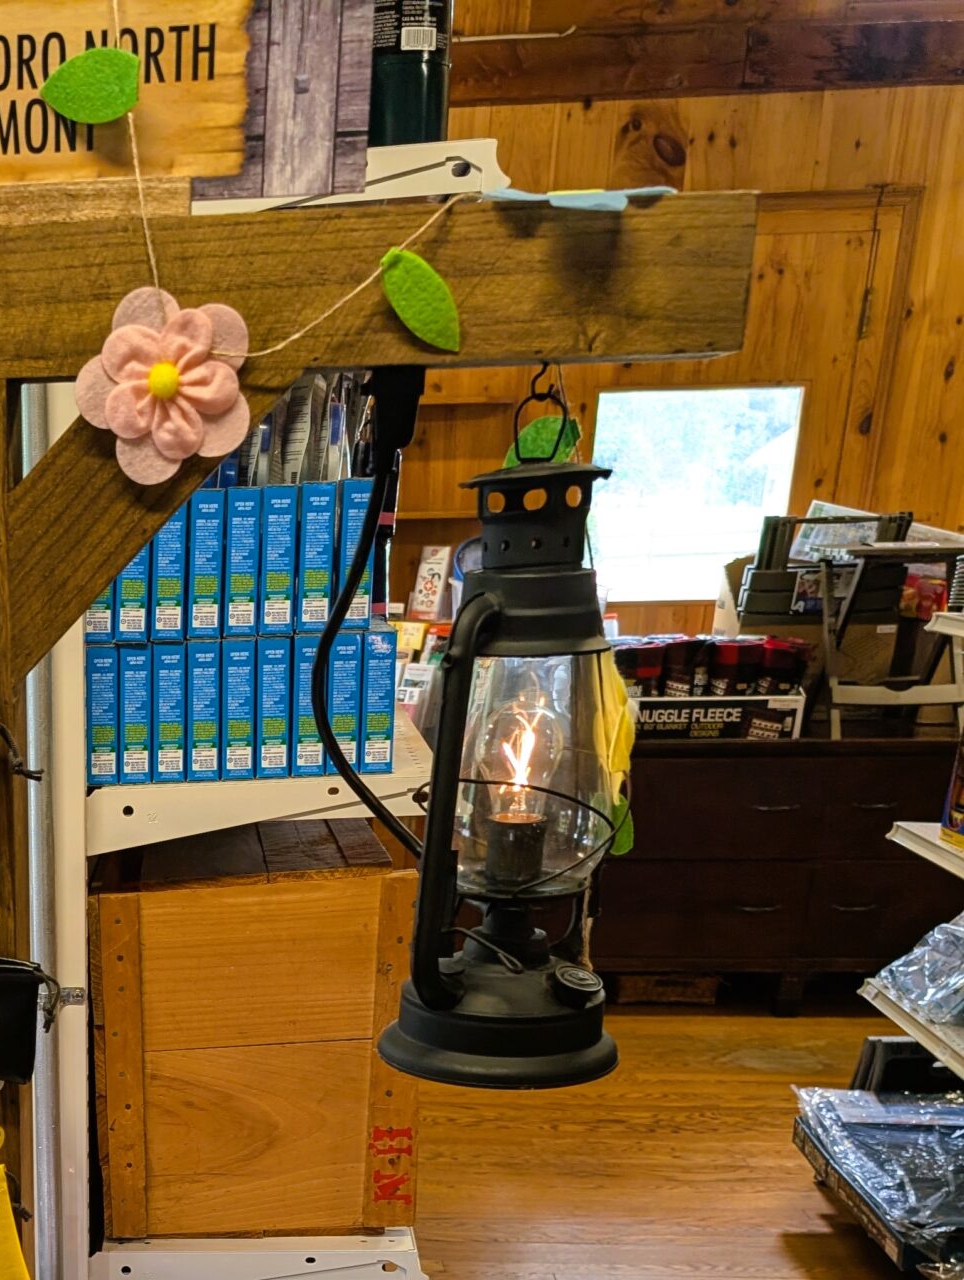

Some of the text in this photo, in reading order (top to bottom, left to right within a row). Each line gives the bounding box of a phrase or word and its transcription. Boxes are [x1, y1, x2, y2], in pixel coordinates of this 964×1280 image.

[86, 24, 216, 84] RTH
[636, 708, 742, 723] NUGGLE FLEECE
